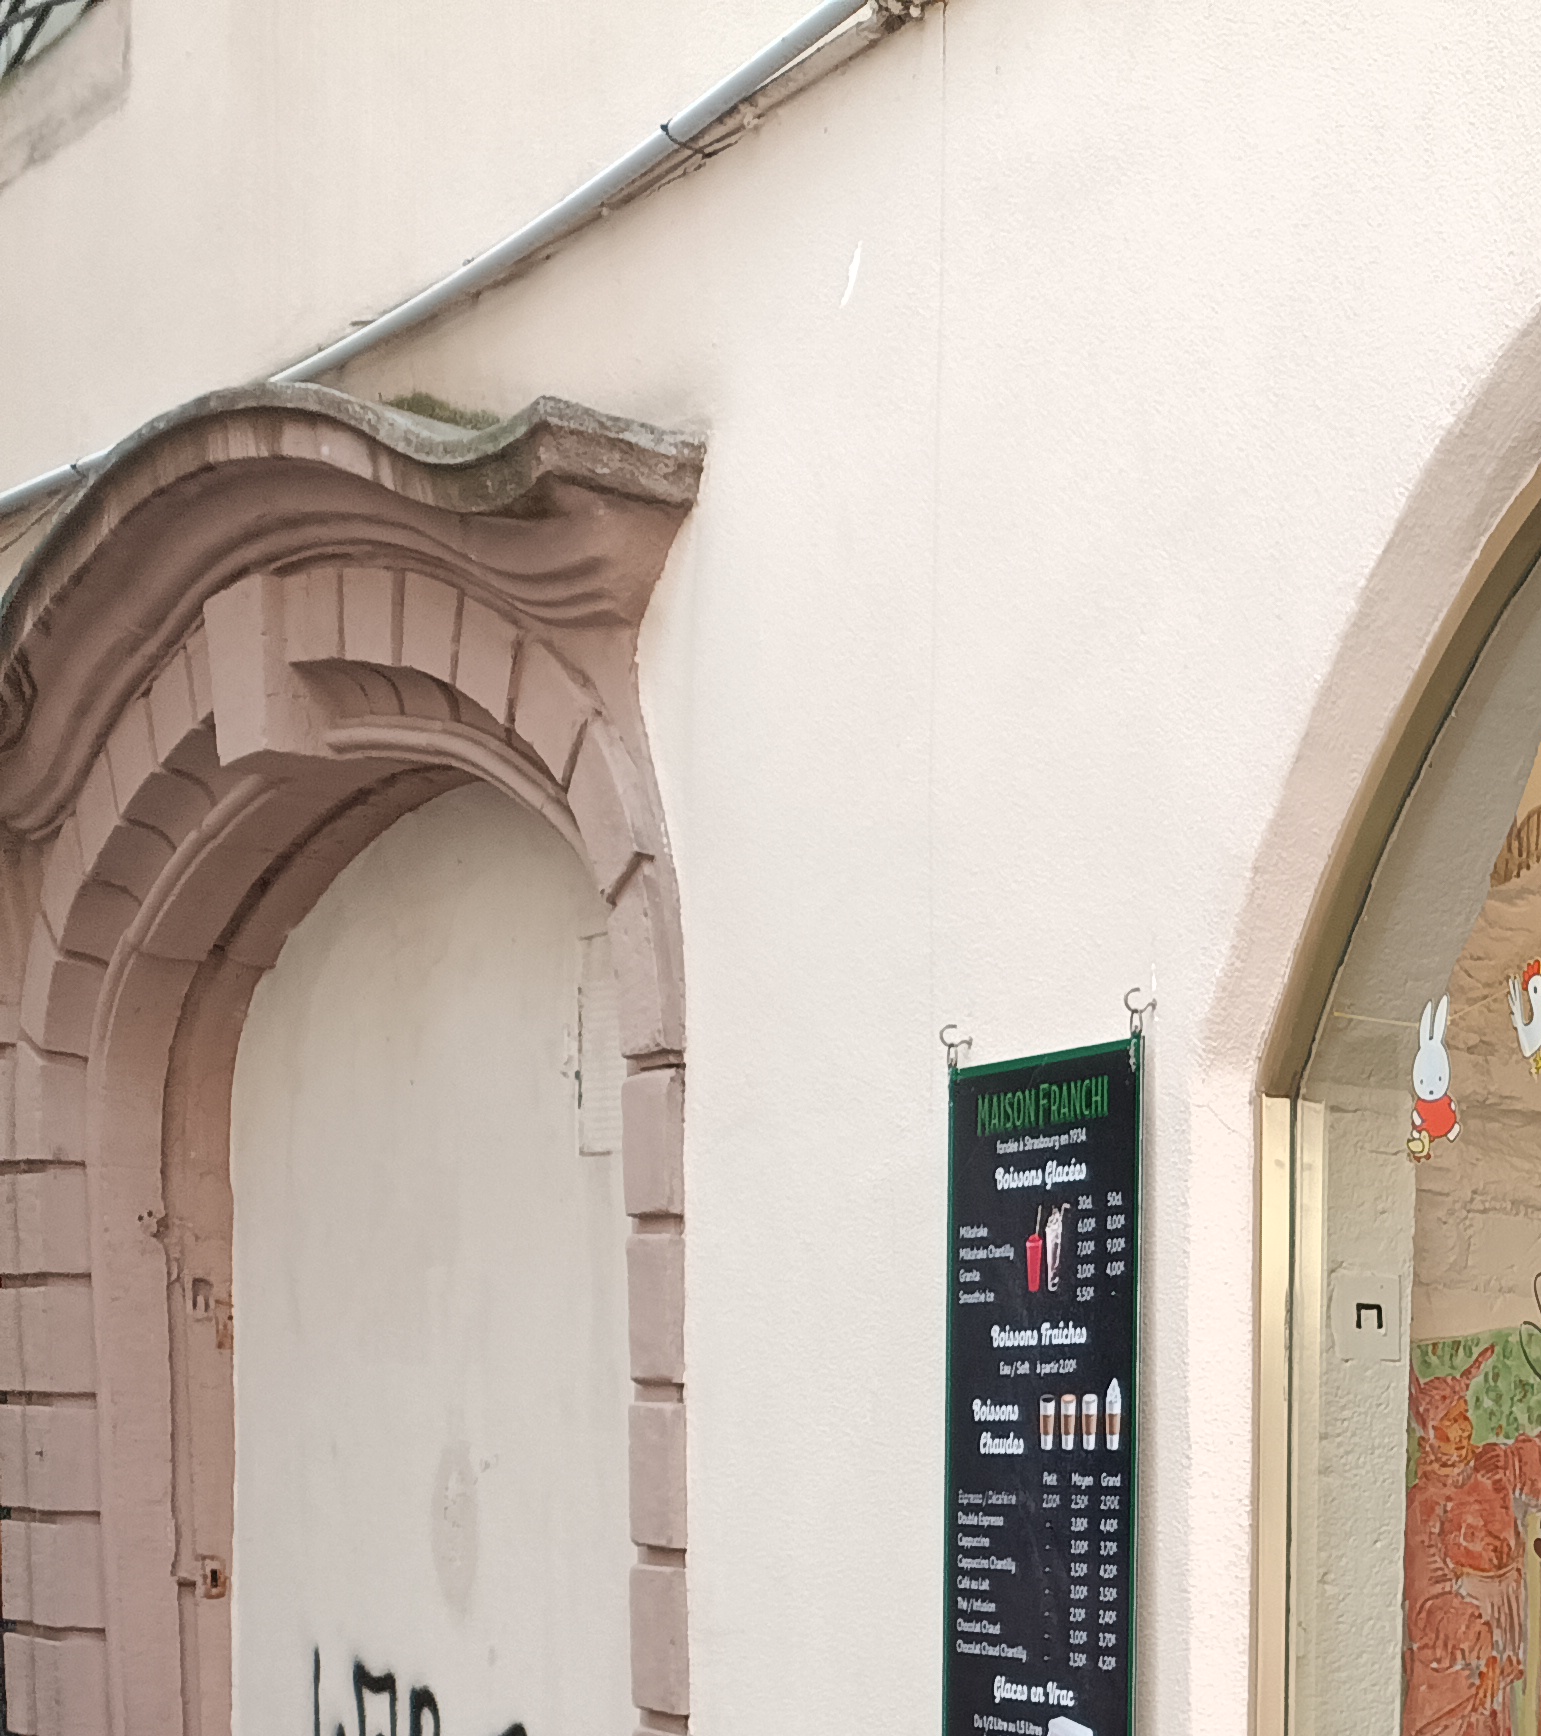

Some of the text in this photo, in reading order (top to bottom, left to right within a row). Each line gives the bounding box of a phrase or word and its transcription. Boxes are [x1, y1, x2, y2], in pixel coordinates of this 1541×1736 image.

[978, 1076, 1109, 1135] MAISON FRANCHI
[1024, 1135, 1059, 1150] Strasbourg
[1070, 1128, 1086, 1143] 1934
[995, 1158, 1086, 1190] Boissons Glacées
[991, 1321, 1087, 1347] Boissons Fraîches
[972, 1399, 1019, 1421] Boissons
[980, 1432, 1024, 1454] Chaudes
[1101, 1473, 1121, 1486] Grand
[994, 1676, 1074, 1706] Glaces en Vrac
